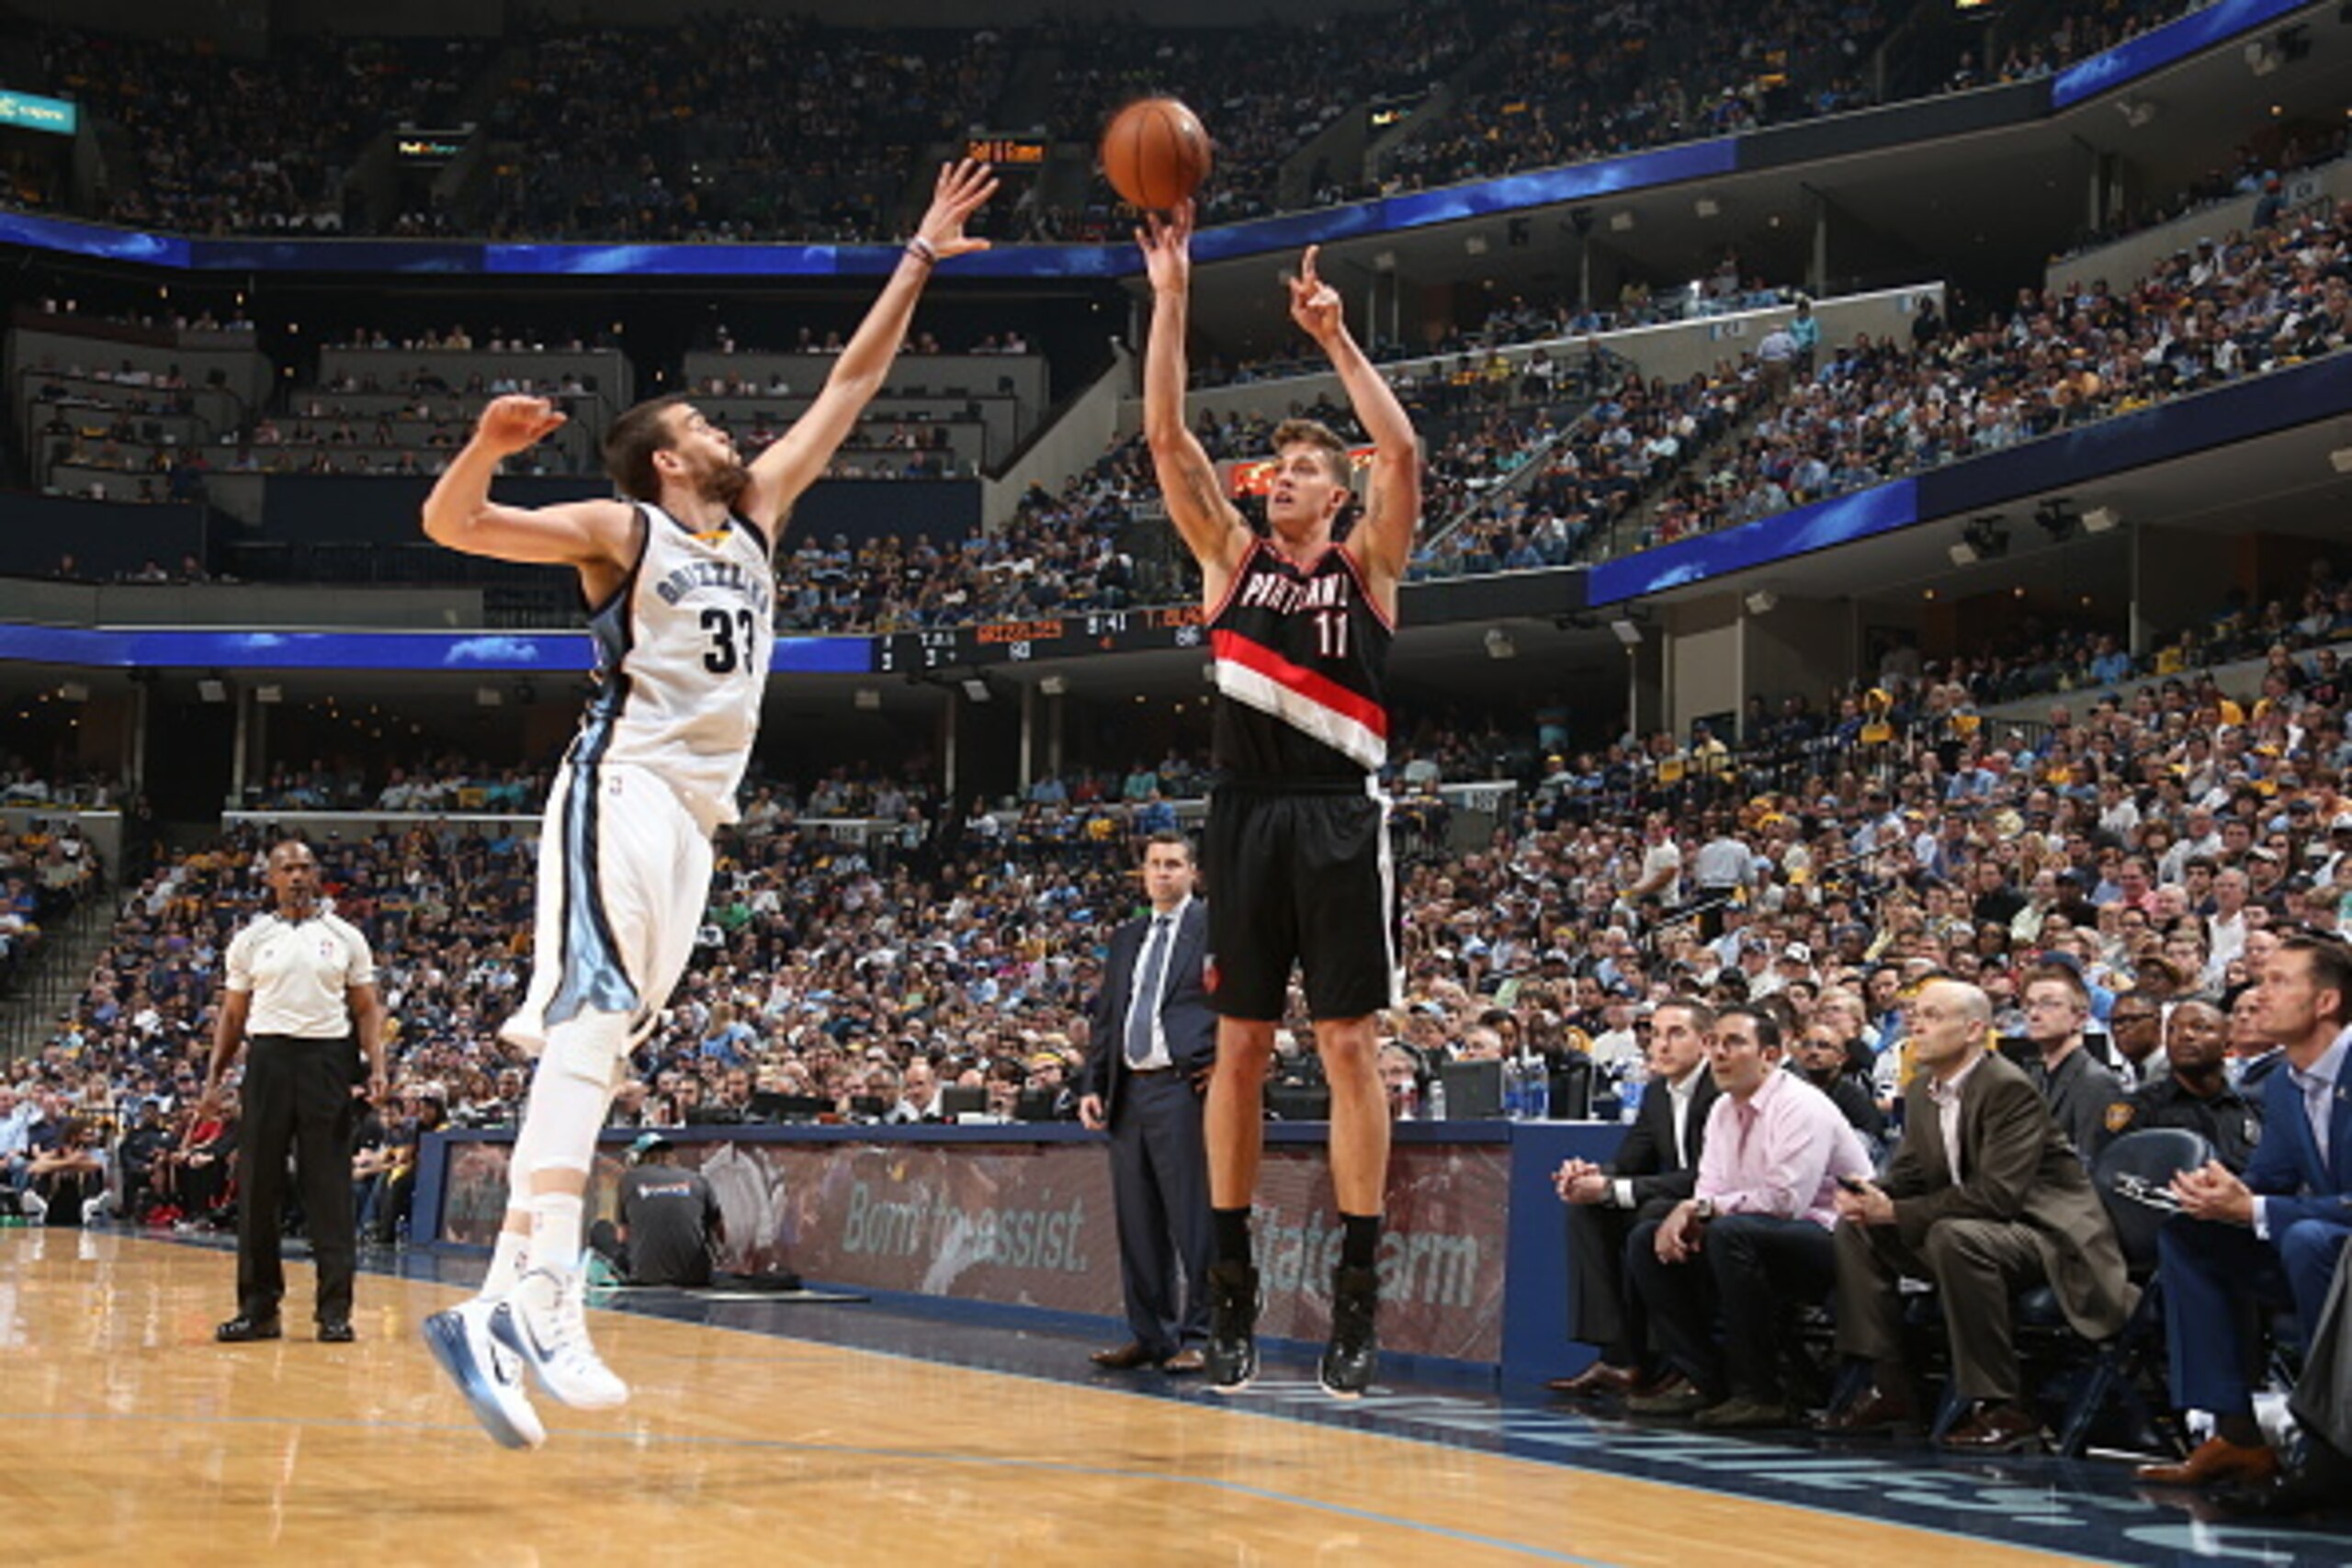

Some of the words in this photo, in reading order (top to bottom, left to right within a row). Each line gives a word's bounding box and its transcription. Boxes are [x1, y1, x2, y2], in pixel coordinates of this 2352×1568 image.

[699, 608, 753, 677] 33
[1314, 611, 1348, 658] 11
[842, 1181, 918, 1256] Born
[973, 1188, 1088, 1271] assist.
[1375, 1231, 1478, 1308] arm
